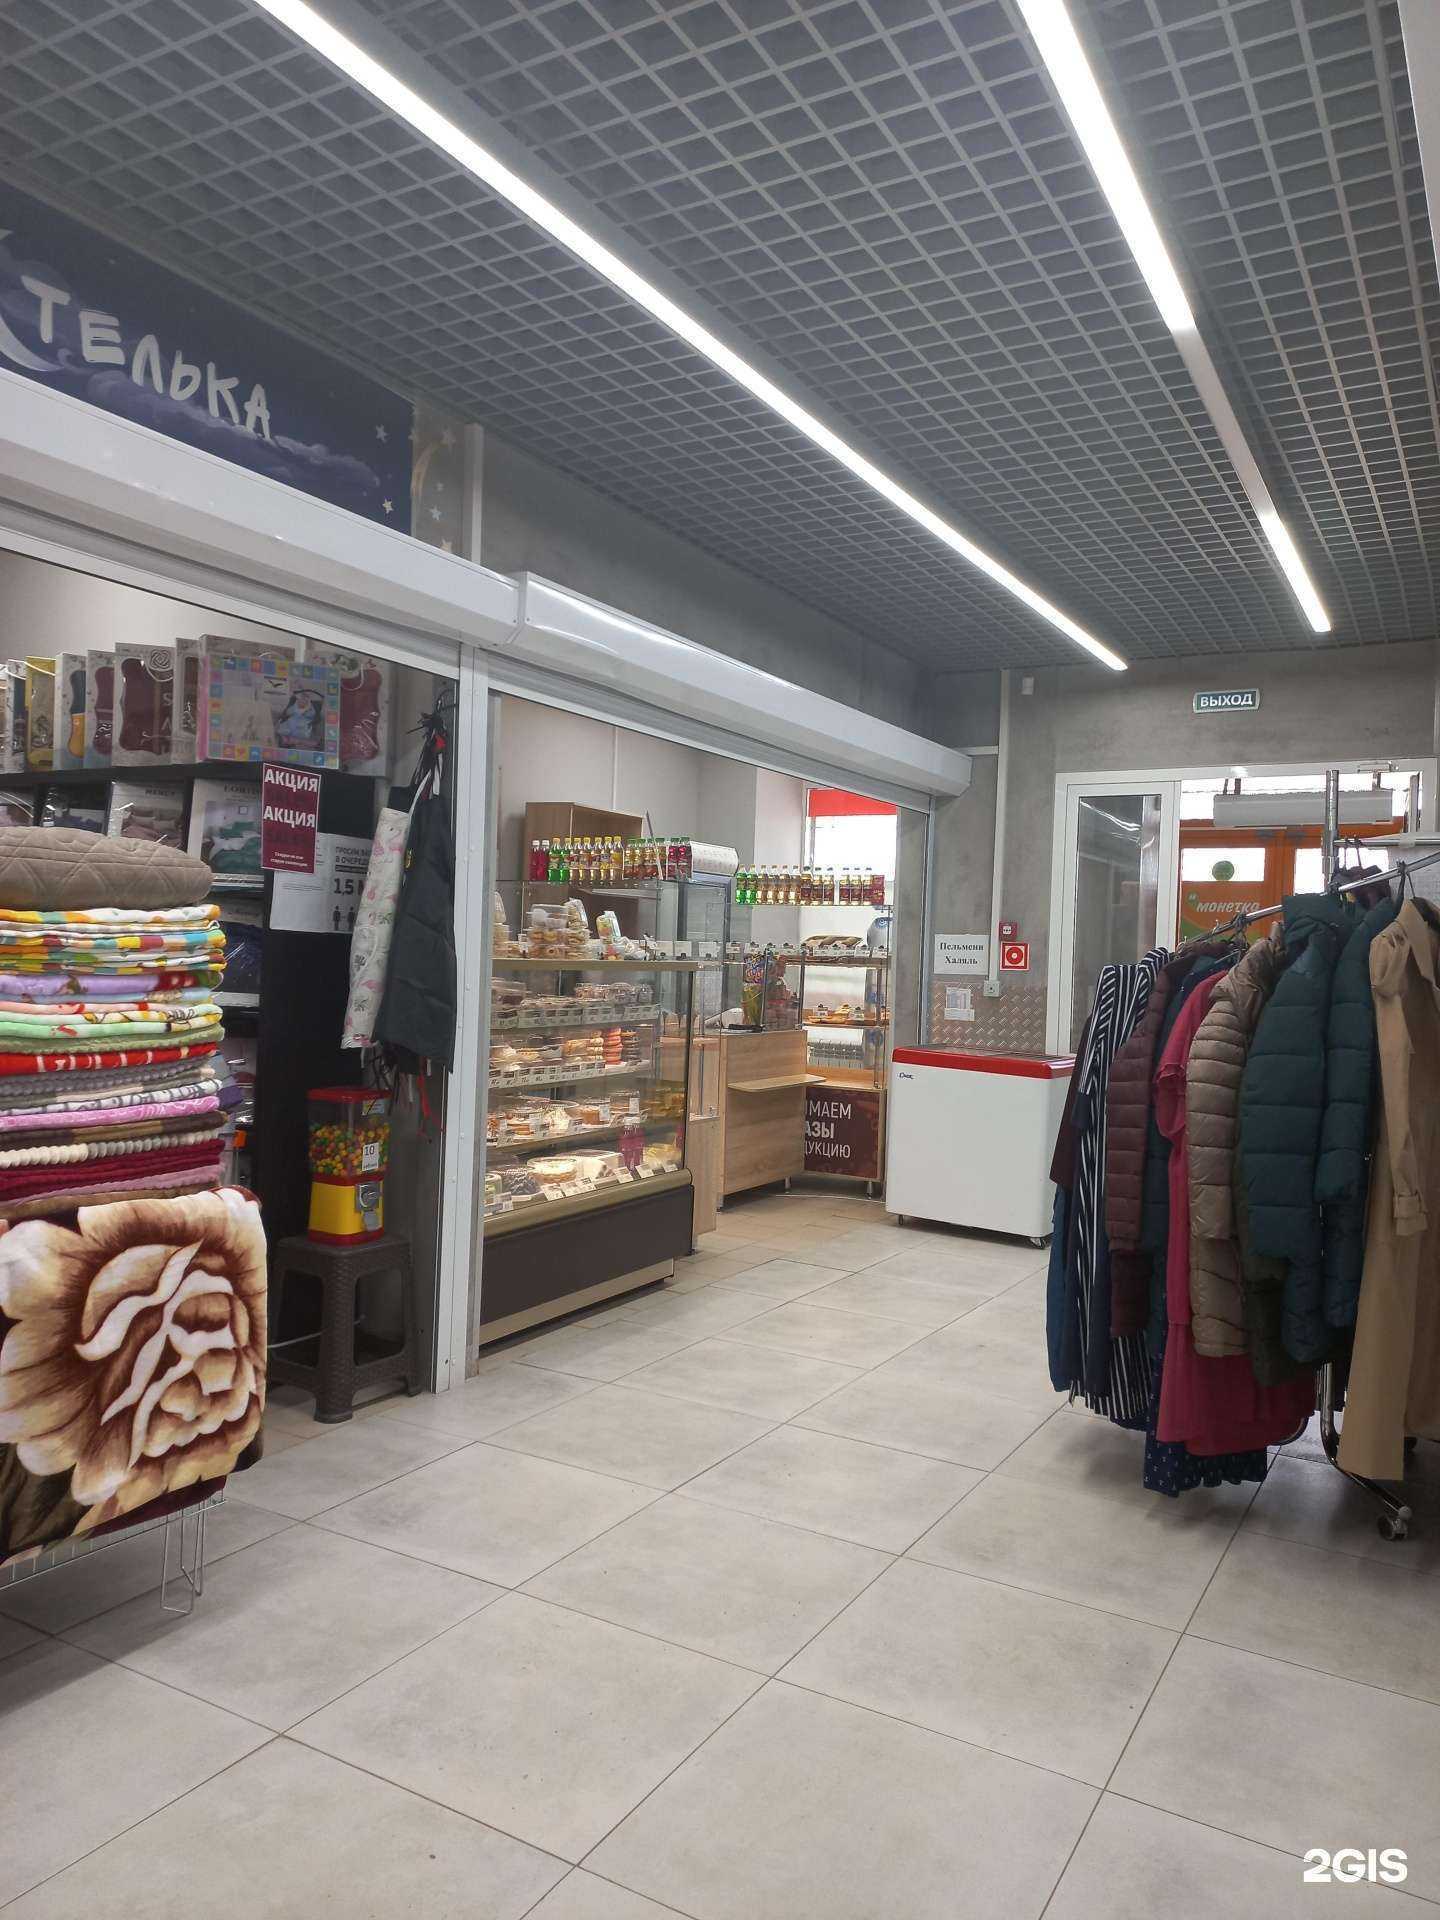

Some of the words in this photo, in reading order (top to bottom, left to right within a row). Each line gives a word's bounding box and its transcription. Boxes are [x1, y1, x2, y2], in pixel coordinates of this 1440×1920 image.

[1200, 693, 1253, 707] ВЫХОД
[264, 768, 318, 793] АКЦИЯ
[263, 805, 316, 829] АКЦИЯ
[940, 942, 984, 951] Пельмени
[945, 956, 978, 965] Халяль
